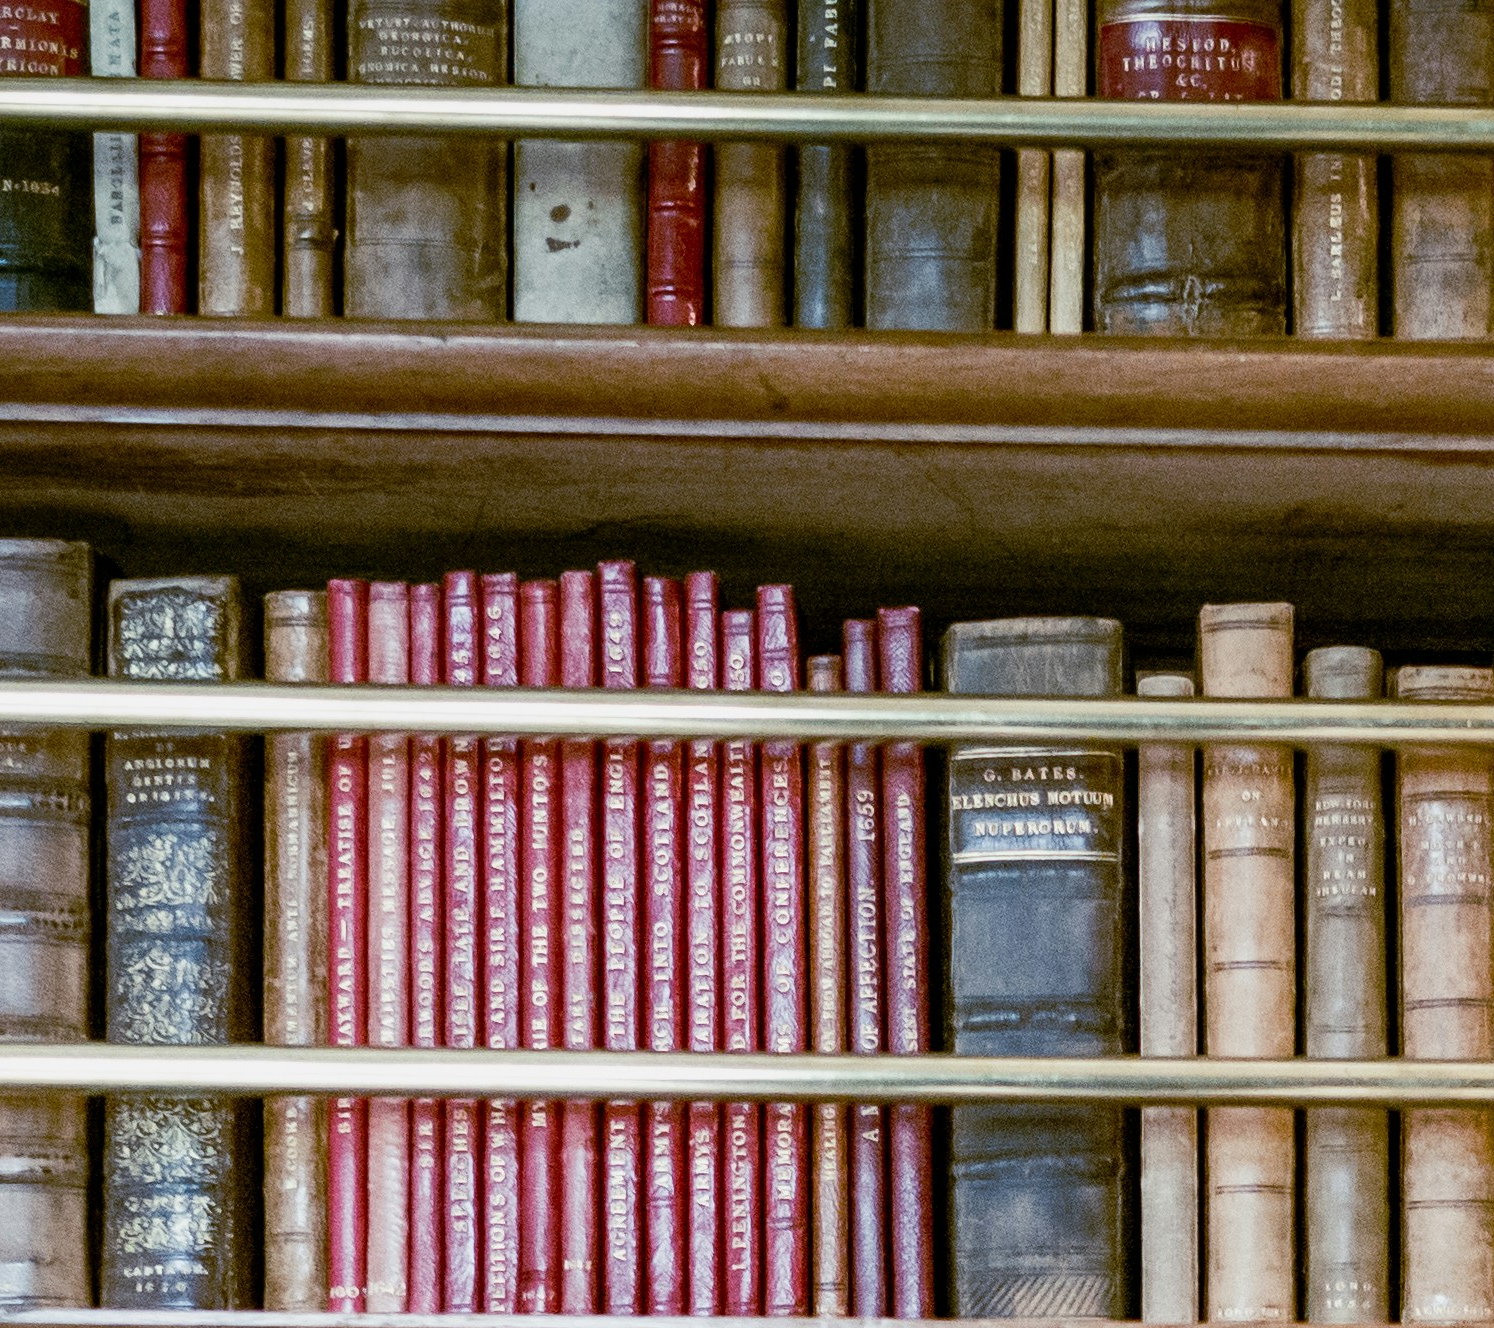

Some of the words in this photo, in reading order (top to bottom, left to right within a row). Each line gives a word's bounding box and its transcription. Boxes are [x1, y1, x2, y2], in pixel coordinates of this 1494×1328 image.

[608, 611, 624, 674] 1649
[338, 765, 352, 792] OF
[858, 789, 875, 842] 1659
[952, 792, 1040, 810] ELENCHUS
[1047, 791, 1114, 808] MOTUUM
[609, 831, 626, 859] OF
[654, 764, 669, 896] SCOTLAND
[897, 791, 914, 883] ENGLAND
[338, 805, 354, 909] TREATISE
[455, 847, 472, 892] AND
[532, 866, 548, 911] TWO
[693, 883, 710, 910] TO
[899, 896, 915, 920] OF
[608, 877, 626, 970] PEOPLE
[730, 925, 746, 963] THE
[490, 926, 506, 967] SIR
[532, 925, 548, 967] THE
[654, 921, 669, 981] INTO
[901, 926, 917, 990] STATE
[532, 980, 548, 1007] OF
[730, 973, 746, 1020] FOR
[775, 962, 791, 993] OF
[490, 980, 506, 1023] AND
[609, 993, 626, 1035] THE
[489, 1154, 506, 1182] OF
[611, 1120, 628, 1261] AGREEMENT
